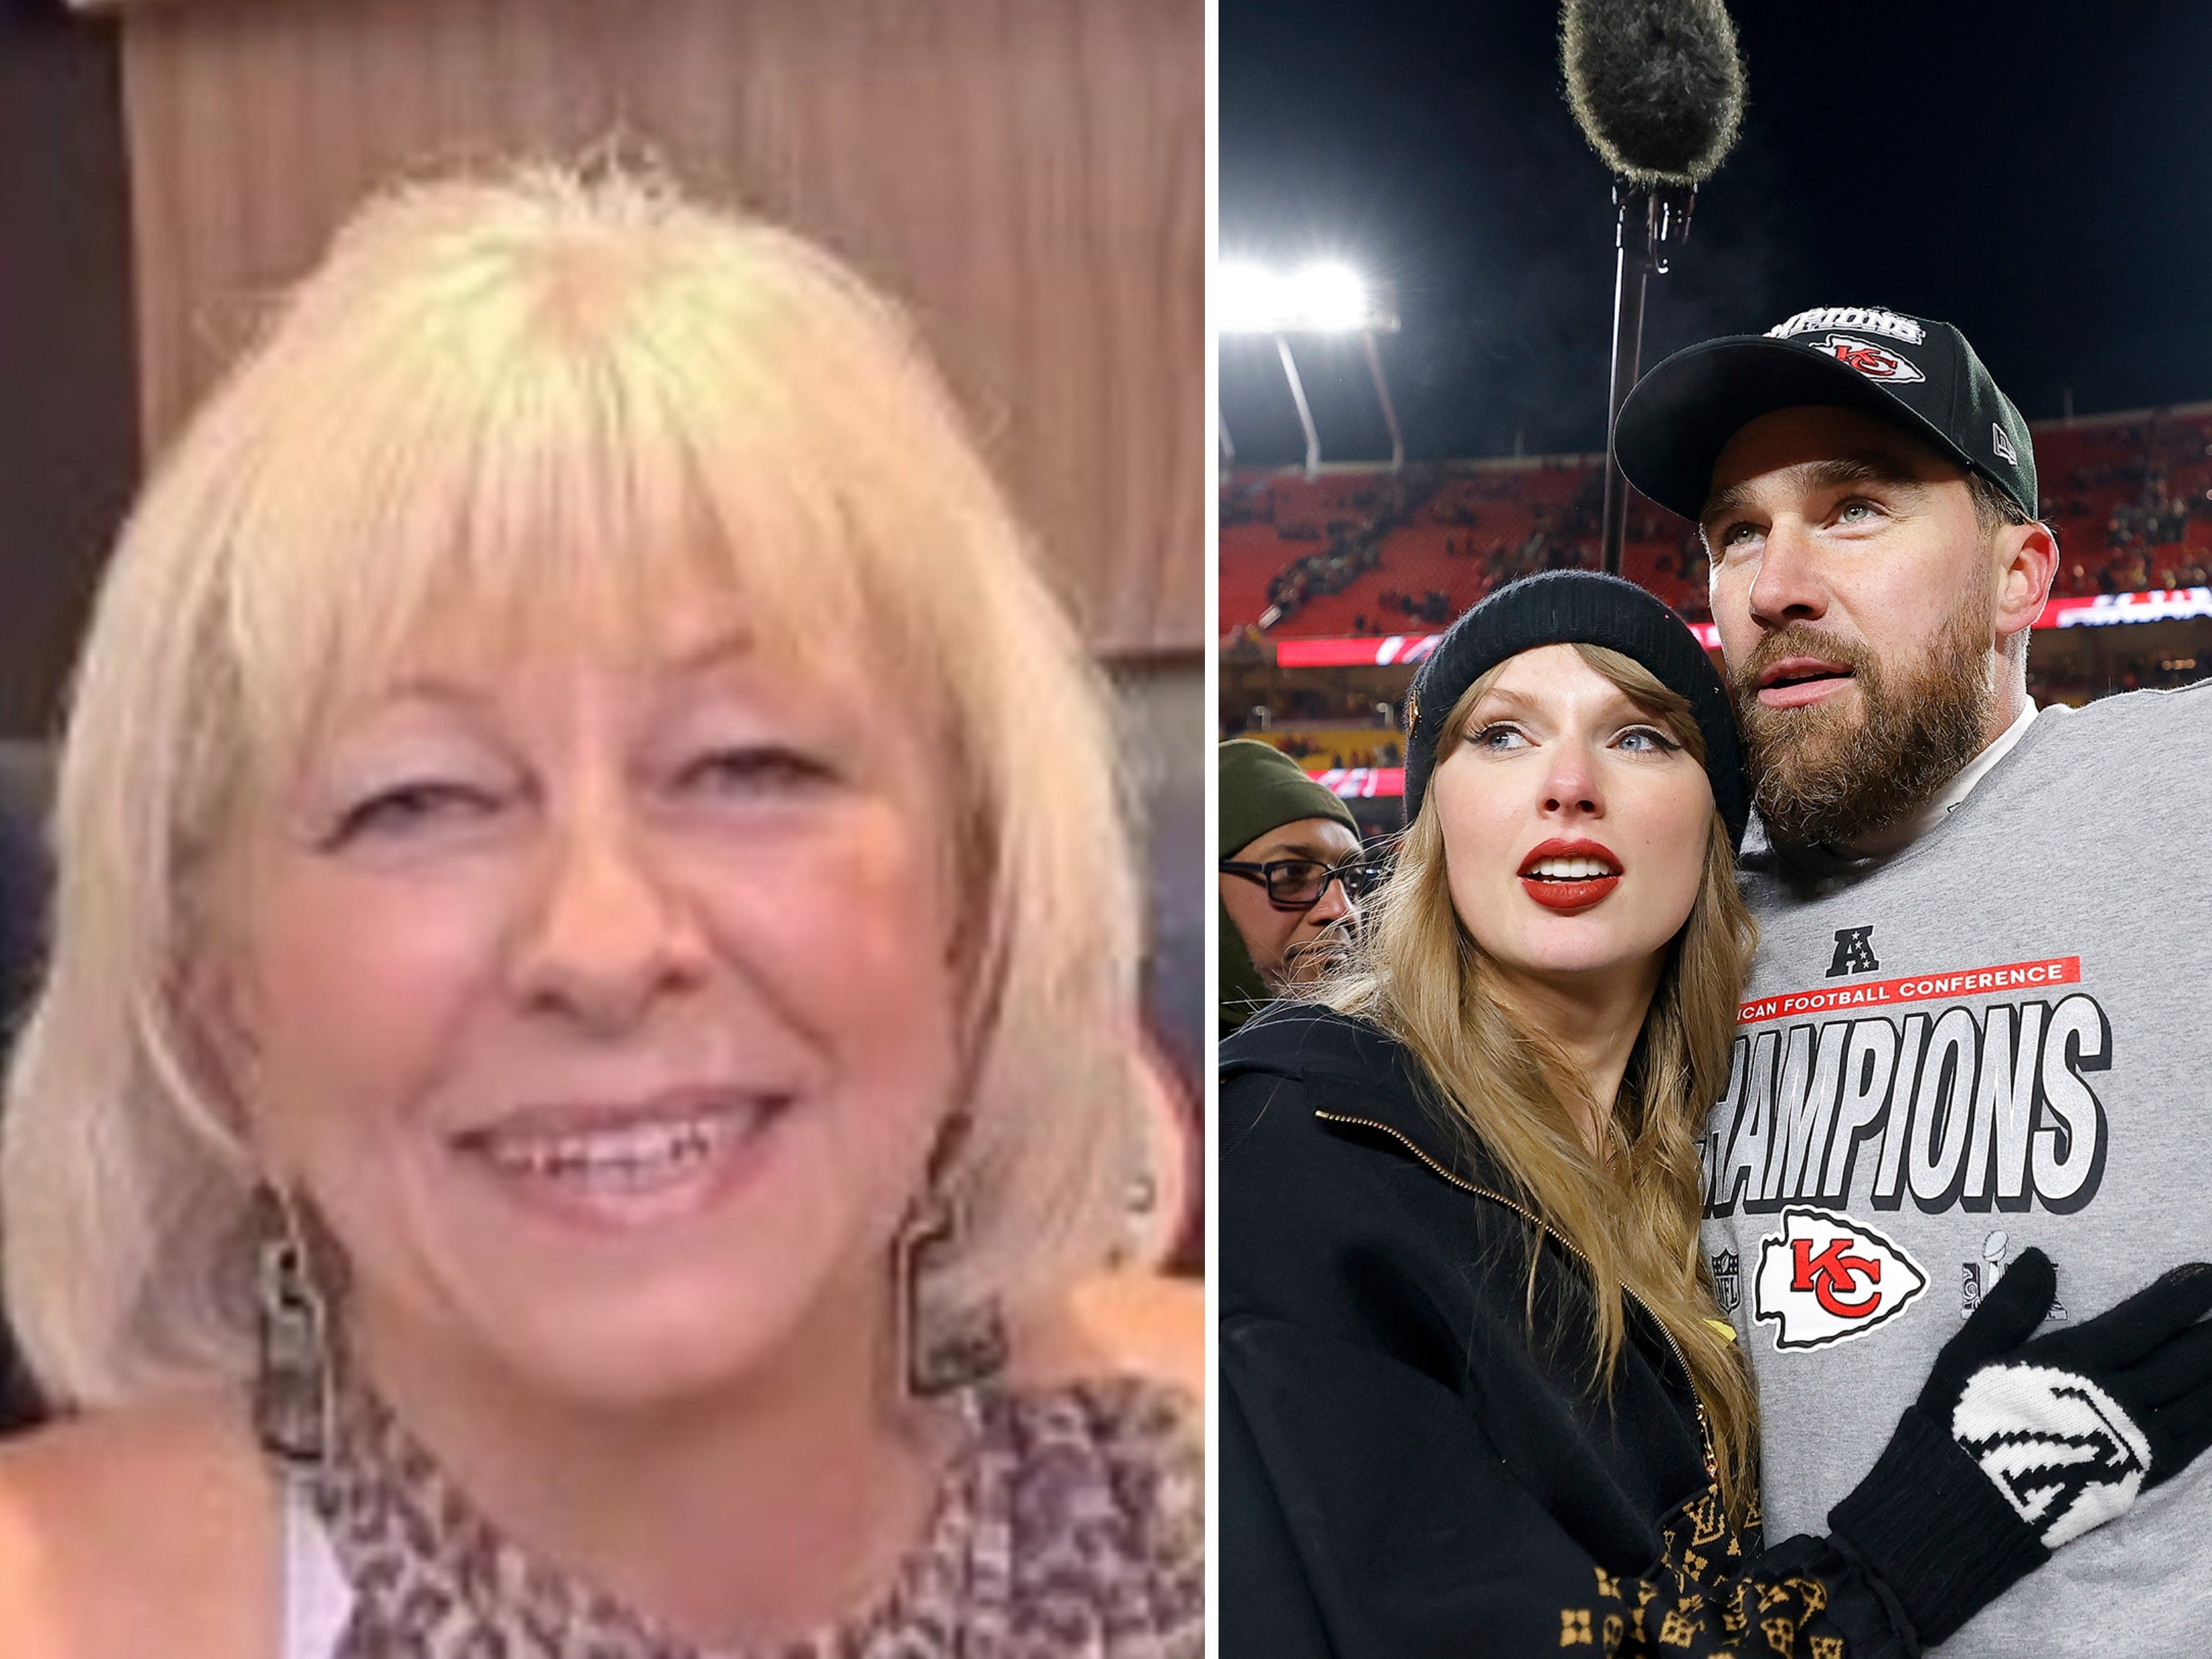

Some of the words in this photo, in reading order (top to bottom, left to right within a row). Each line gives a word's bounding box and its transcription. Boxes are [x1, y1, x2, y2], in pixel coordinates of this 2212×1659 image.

[1736, 1002, 1776, 1021] ICAN
[1784, 986, 1890, 1012] FOOTBALL
[1899, 964, 2063, 997] CONFERENCE
[1698, 993, 2112, 1219] HAMPIONS
[1791, 1238, 1882, 1318] KC
